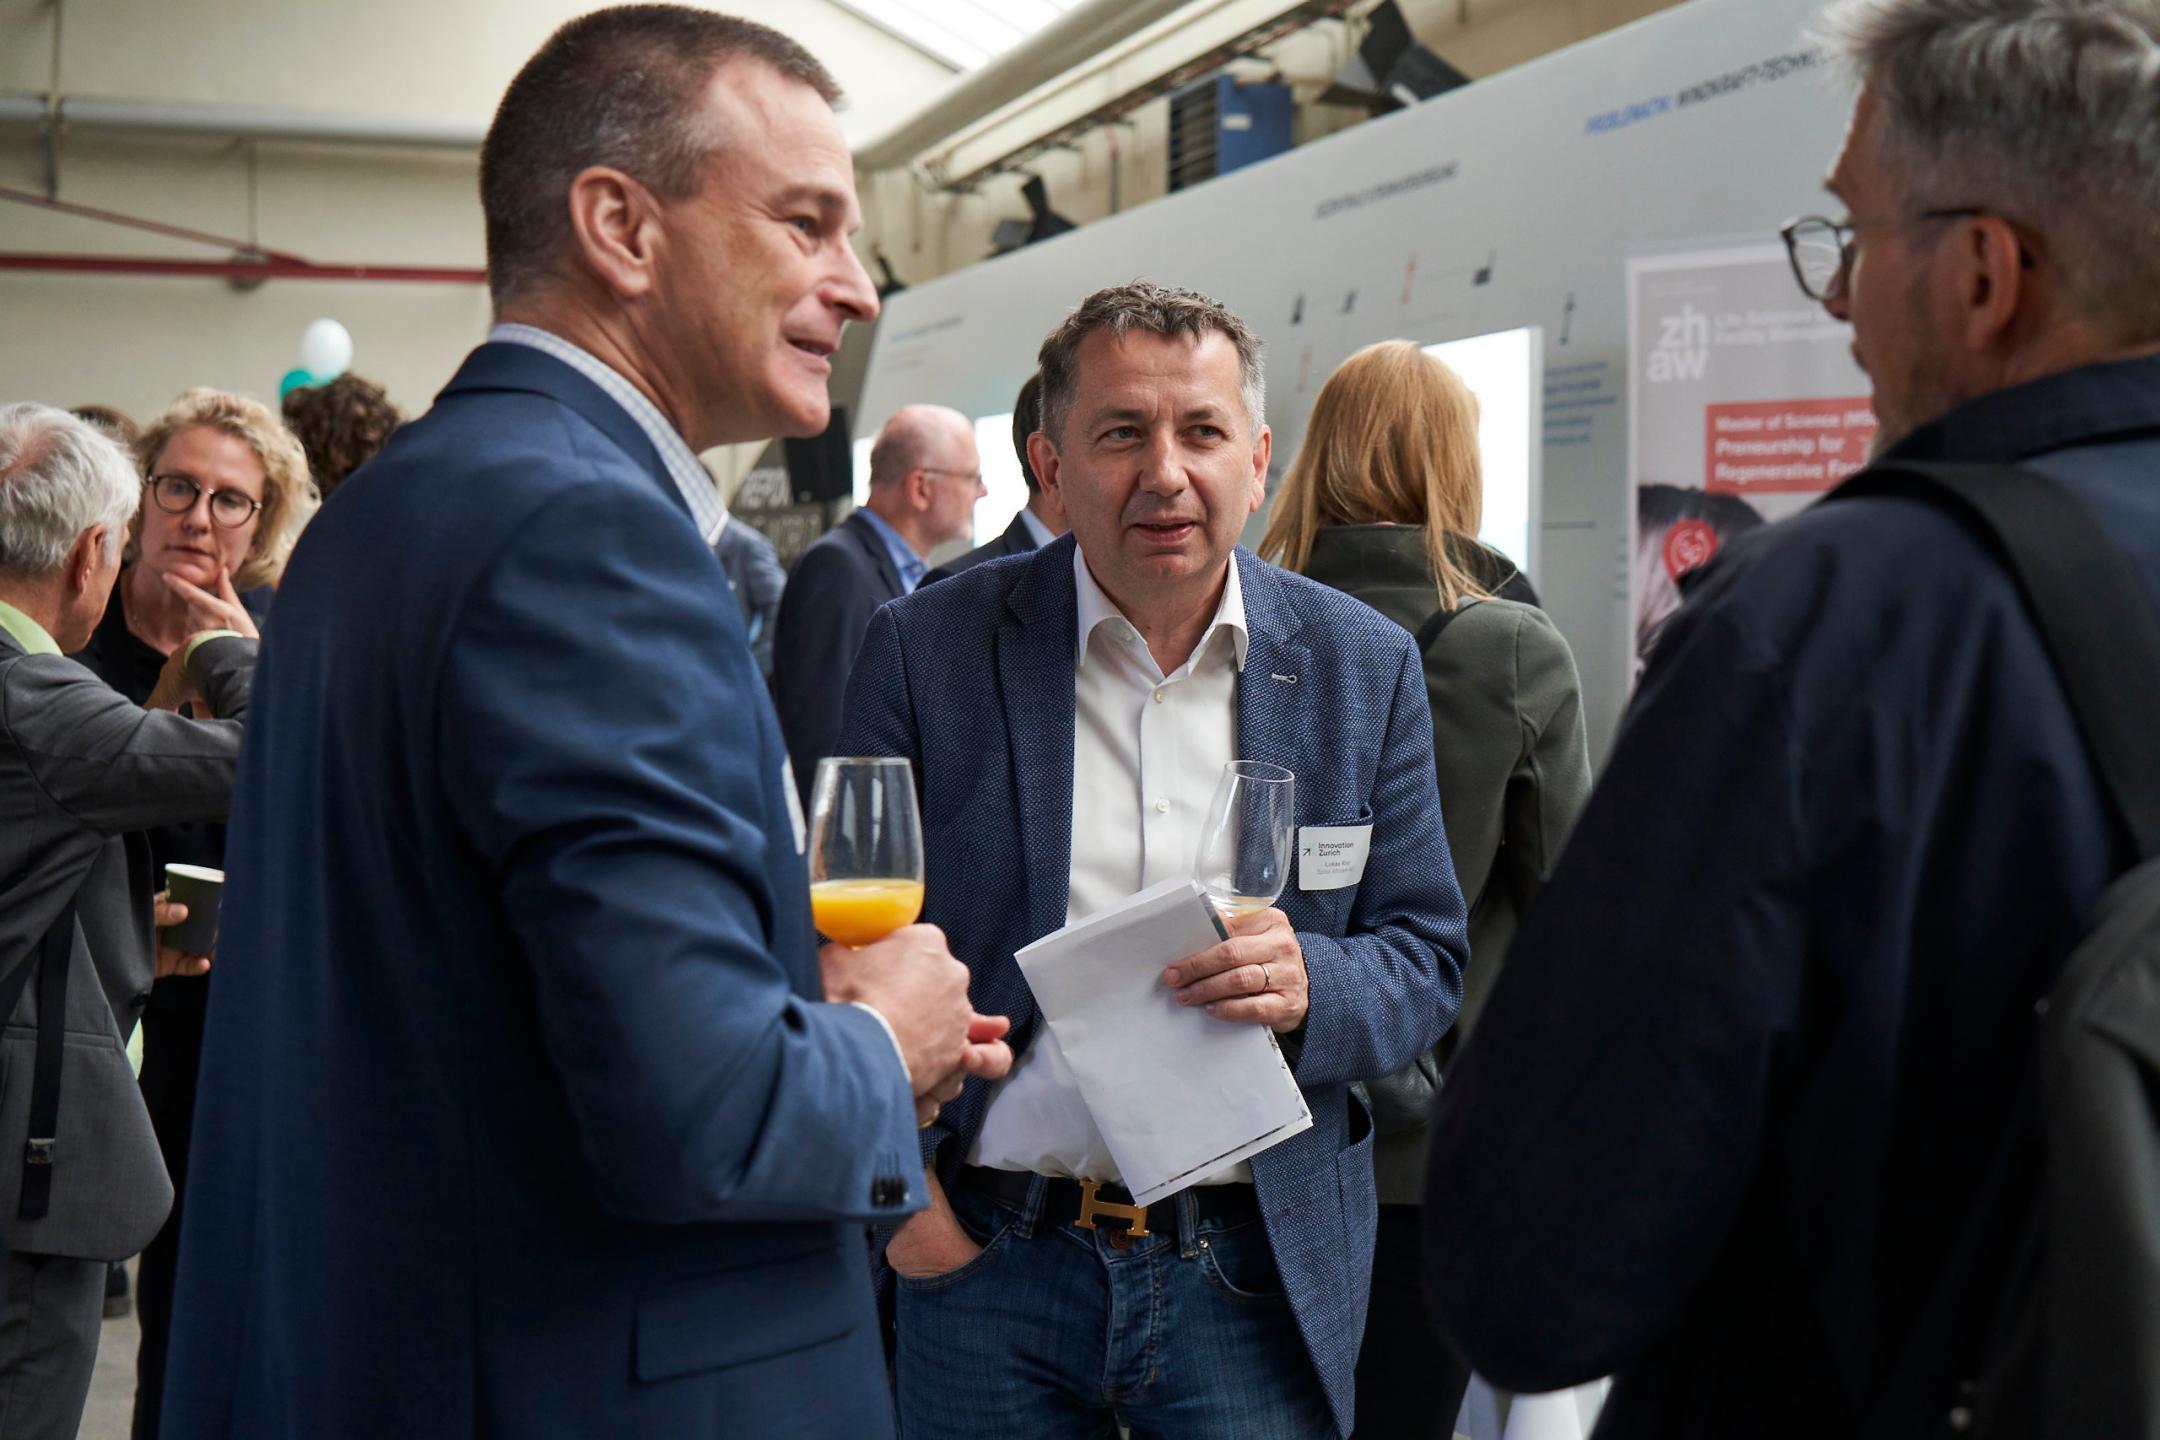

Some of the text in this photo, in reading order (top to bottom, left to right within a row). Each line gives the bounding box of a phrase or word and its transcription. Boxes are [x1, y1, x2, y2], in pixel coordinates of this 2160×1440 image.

[1658, 303, 1708, 349] zh
[1648, 350, 1710, 383] aw
[1715, 416, 1763, 431] Master
[1766, 415, 1783, 430] of
[1784, 413, 1840, 428] Science
[1818, 434, 1845, 453] for
[1715, 462, 1823, 485] Regenerative
[1318, 841, 1354, 849] Innovation
[1318, 849, 1341, 857] Zurich
